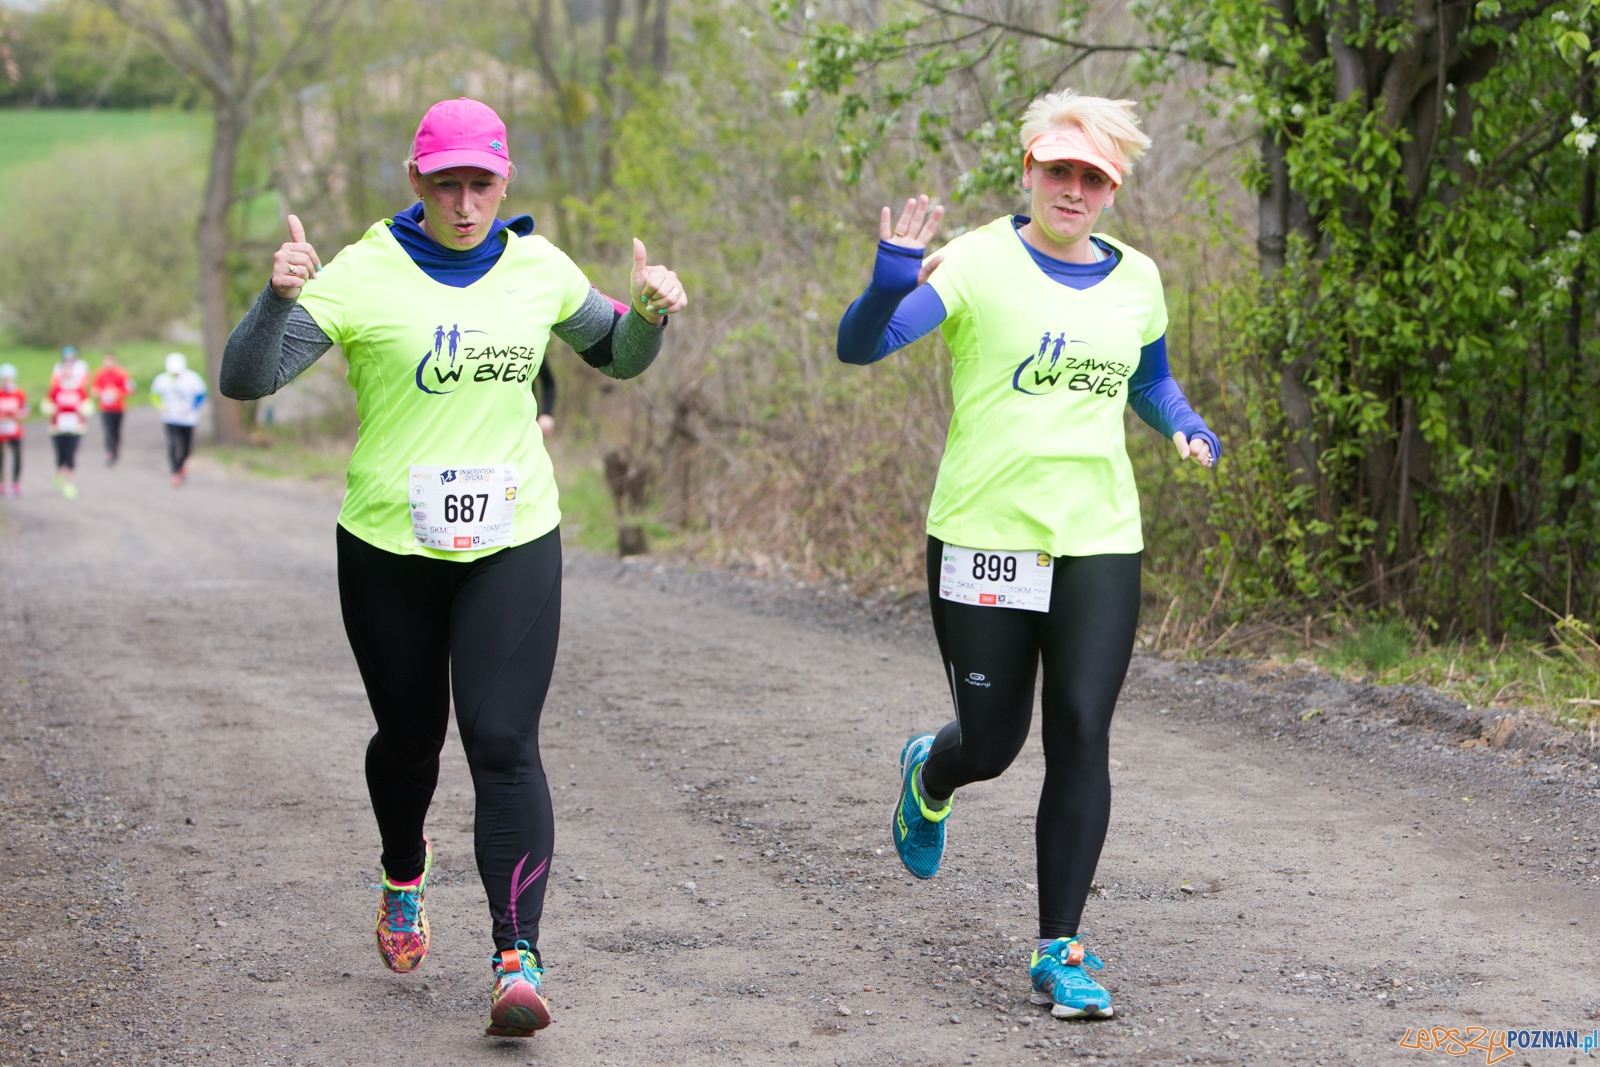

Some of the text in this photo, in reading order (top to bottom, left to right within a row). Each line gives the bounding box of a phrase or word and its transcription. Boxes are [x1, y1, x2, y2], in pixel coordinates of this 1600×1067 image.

[464, 346, 535, 360] ZAWSZE
[434, 364, 463, 384] W
[1066, 357, 1130, 377] ZAWSZE
[1034, 370, 1062, 386] W
[444, 494, 489, 523] 687
[430, 526, 447, 534] 5KM
[972, 552, 1017, 582] 899
[957, 580, 974, 589] 5KM
[1009, 586, 1031, 594] 10KM
